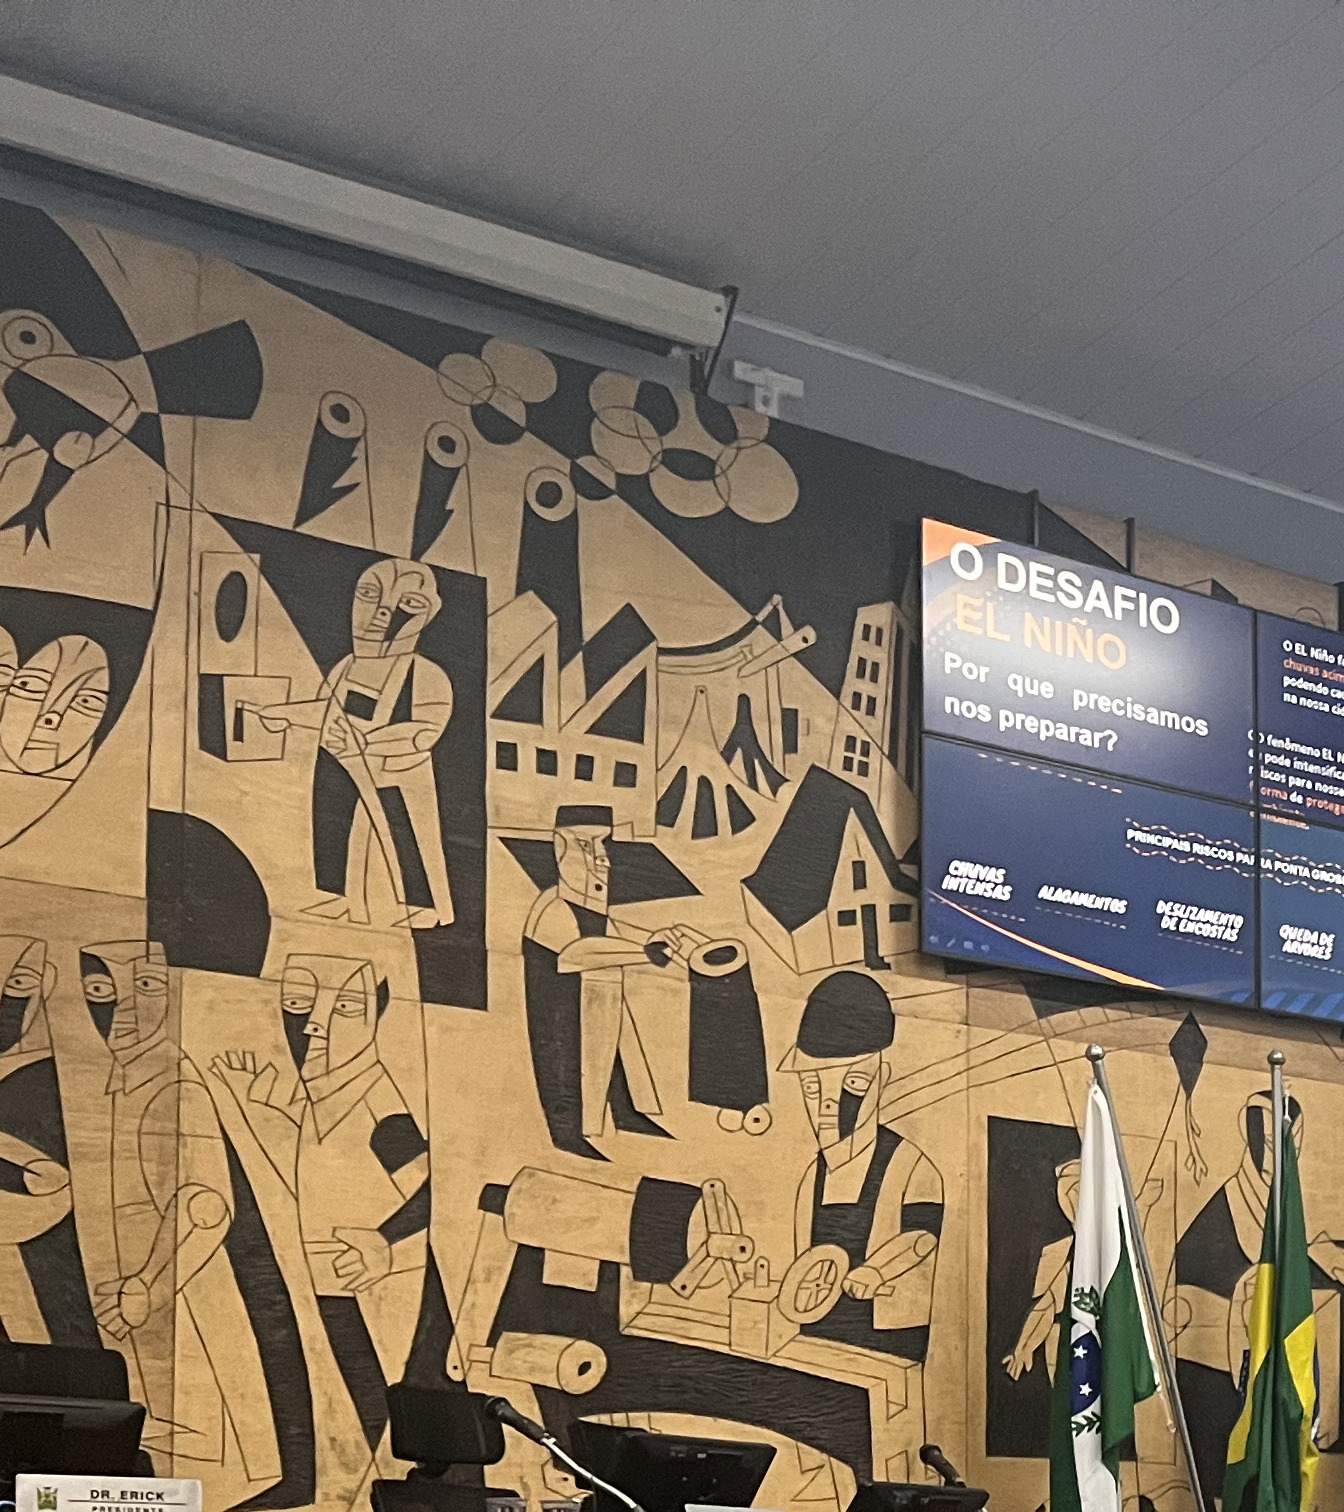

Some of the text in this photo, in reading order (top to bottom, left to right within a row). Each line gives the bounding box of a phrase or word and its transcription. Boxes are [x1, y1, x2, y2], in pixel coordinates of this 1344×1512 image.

[950, 542, 1180, 634] O DESAFIO
[956, 593, 1128, 670] EL NIÑO
[1282, 640, 1293, 652] O
[1294, 642, 1308, 657] EL
[1283, 657, 1320, 676] chuvas
[944, 651, 1209, 737] Por que precisamos
[1283, 675, 1329, 695] podendo
[1283, 692, 1298, 704] na
[1299, 696, 1330, 713] nossa
[944, 695, 1119, 751] nos preparar?
[1264, 752, 1291, 768] pode
[1266, 734, 1321, 758] fenômeno
[1322, 747, 1334, 761] EL
[1288, 775, 1312, 789] para
[1314, 781, 1344, 797] nossa
[1289, 790, 1303, 804] de
[1126, 828, 1191, 853] PRINCIPAIS
[1192, 843, 1235, 862] RISCOS
[1274, 860, 1311, 879] PONTA
[949, 859, 1006, 884] CHUVAS
[941, 874, 1013, 901] INTENSAS
[1037, 884, 1128, 915] ALAGAMENTOS
[1155, 900, 1244, 929] DESLIZAMENTO
[1160, 916, 1239, 942] DE ENCOSTAS
[1279, 923, 1335, 947] QUEDA DE
[90, 1489, 165, 1501] DR. ERICK
